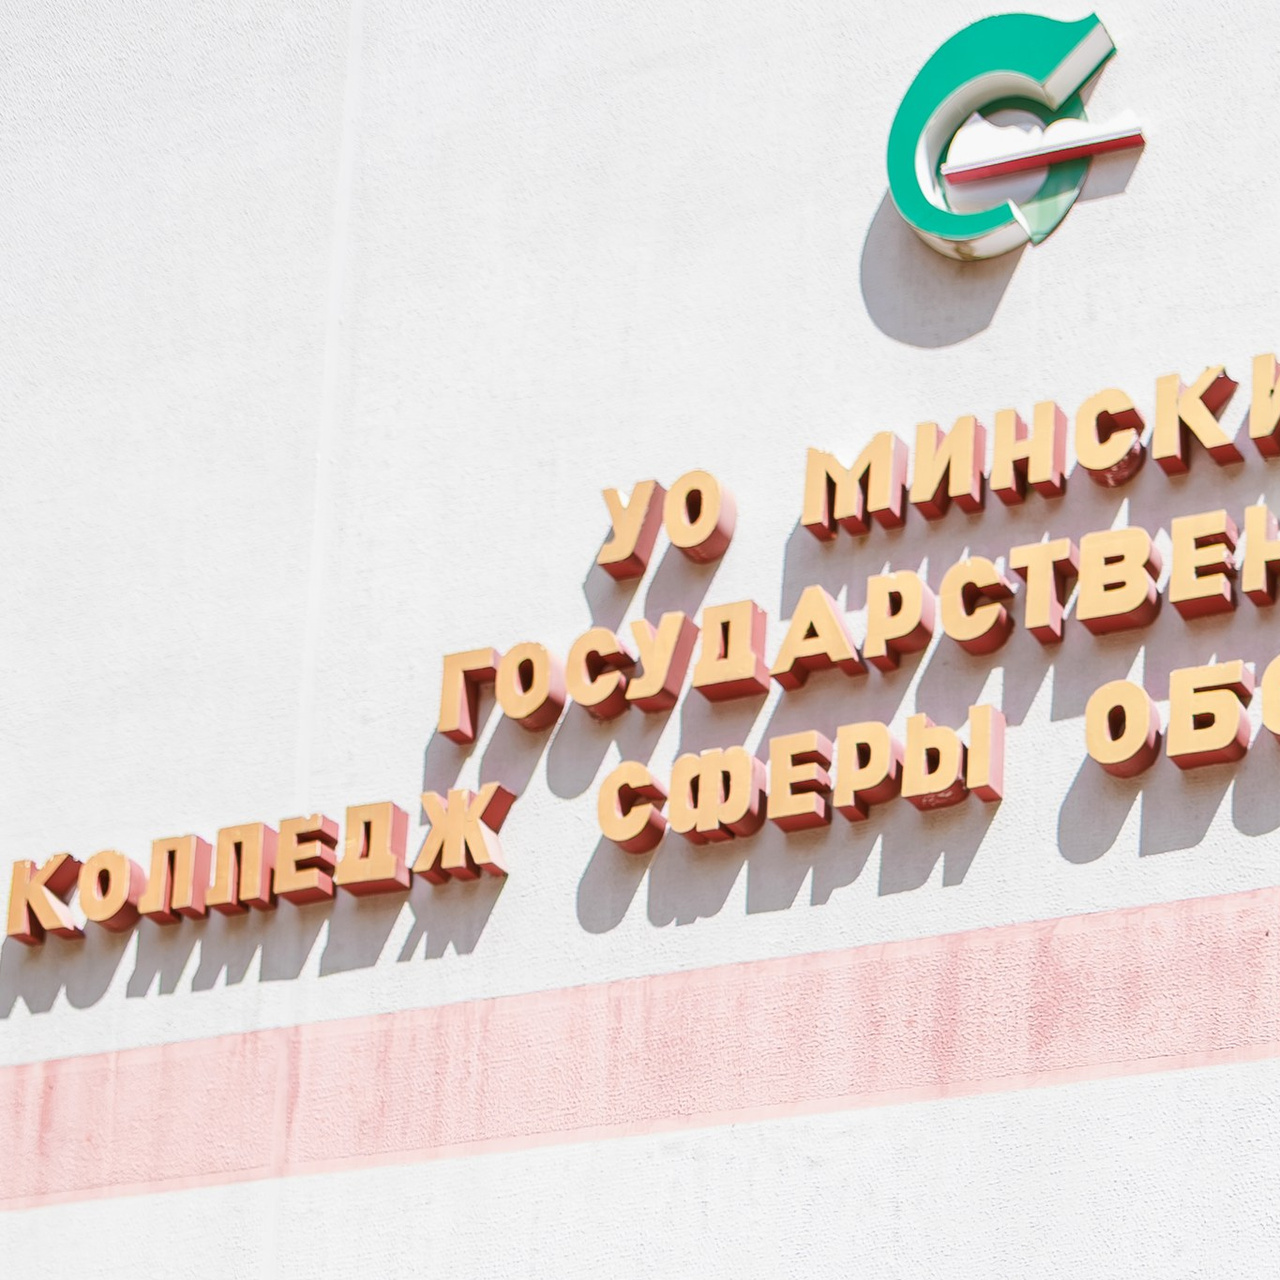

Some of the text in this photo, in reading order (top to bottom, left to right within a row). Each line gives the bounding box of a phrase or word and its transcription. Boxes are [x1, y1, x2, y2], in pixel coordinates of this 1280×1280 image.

[599, 467, 733, 579] УО
[7, 781, 514, 946] КОЛЛЕДЖ
[597, 703, 1005, 855] СФЕРЫ
